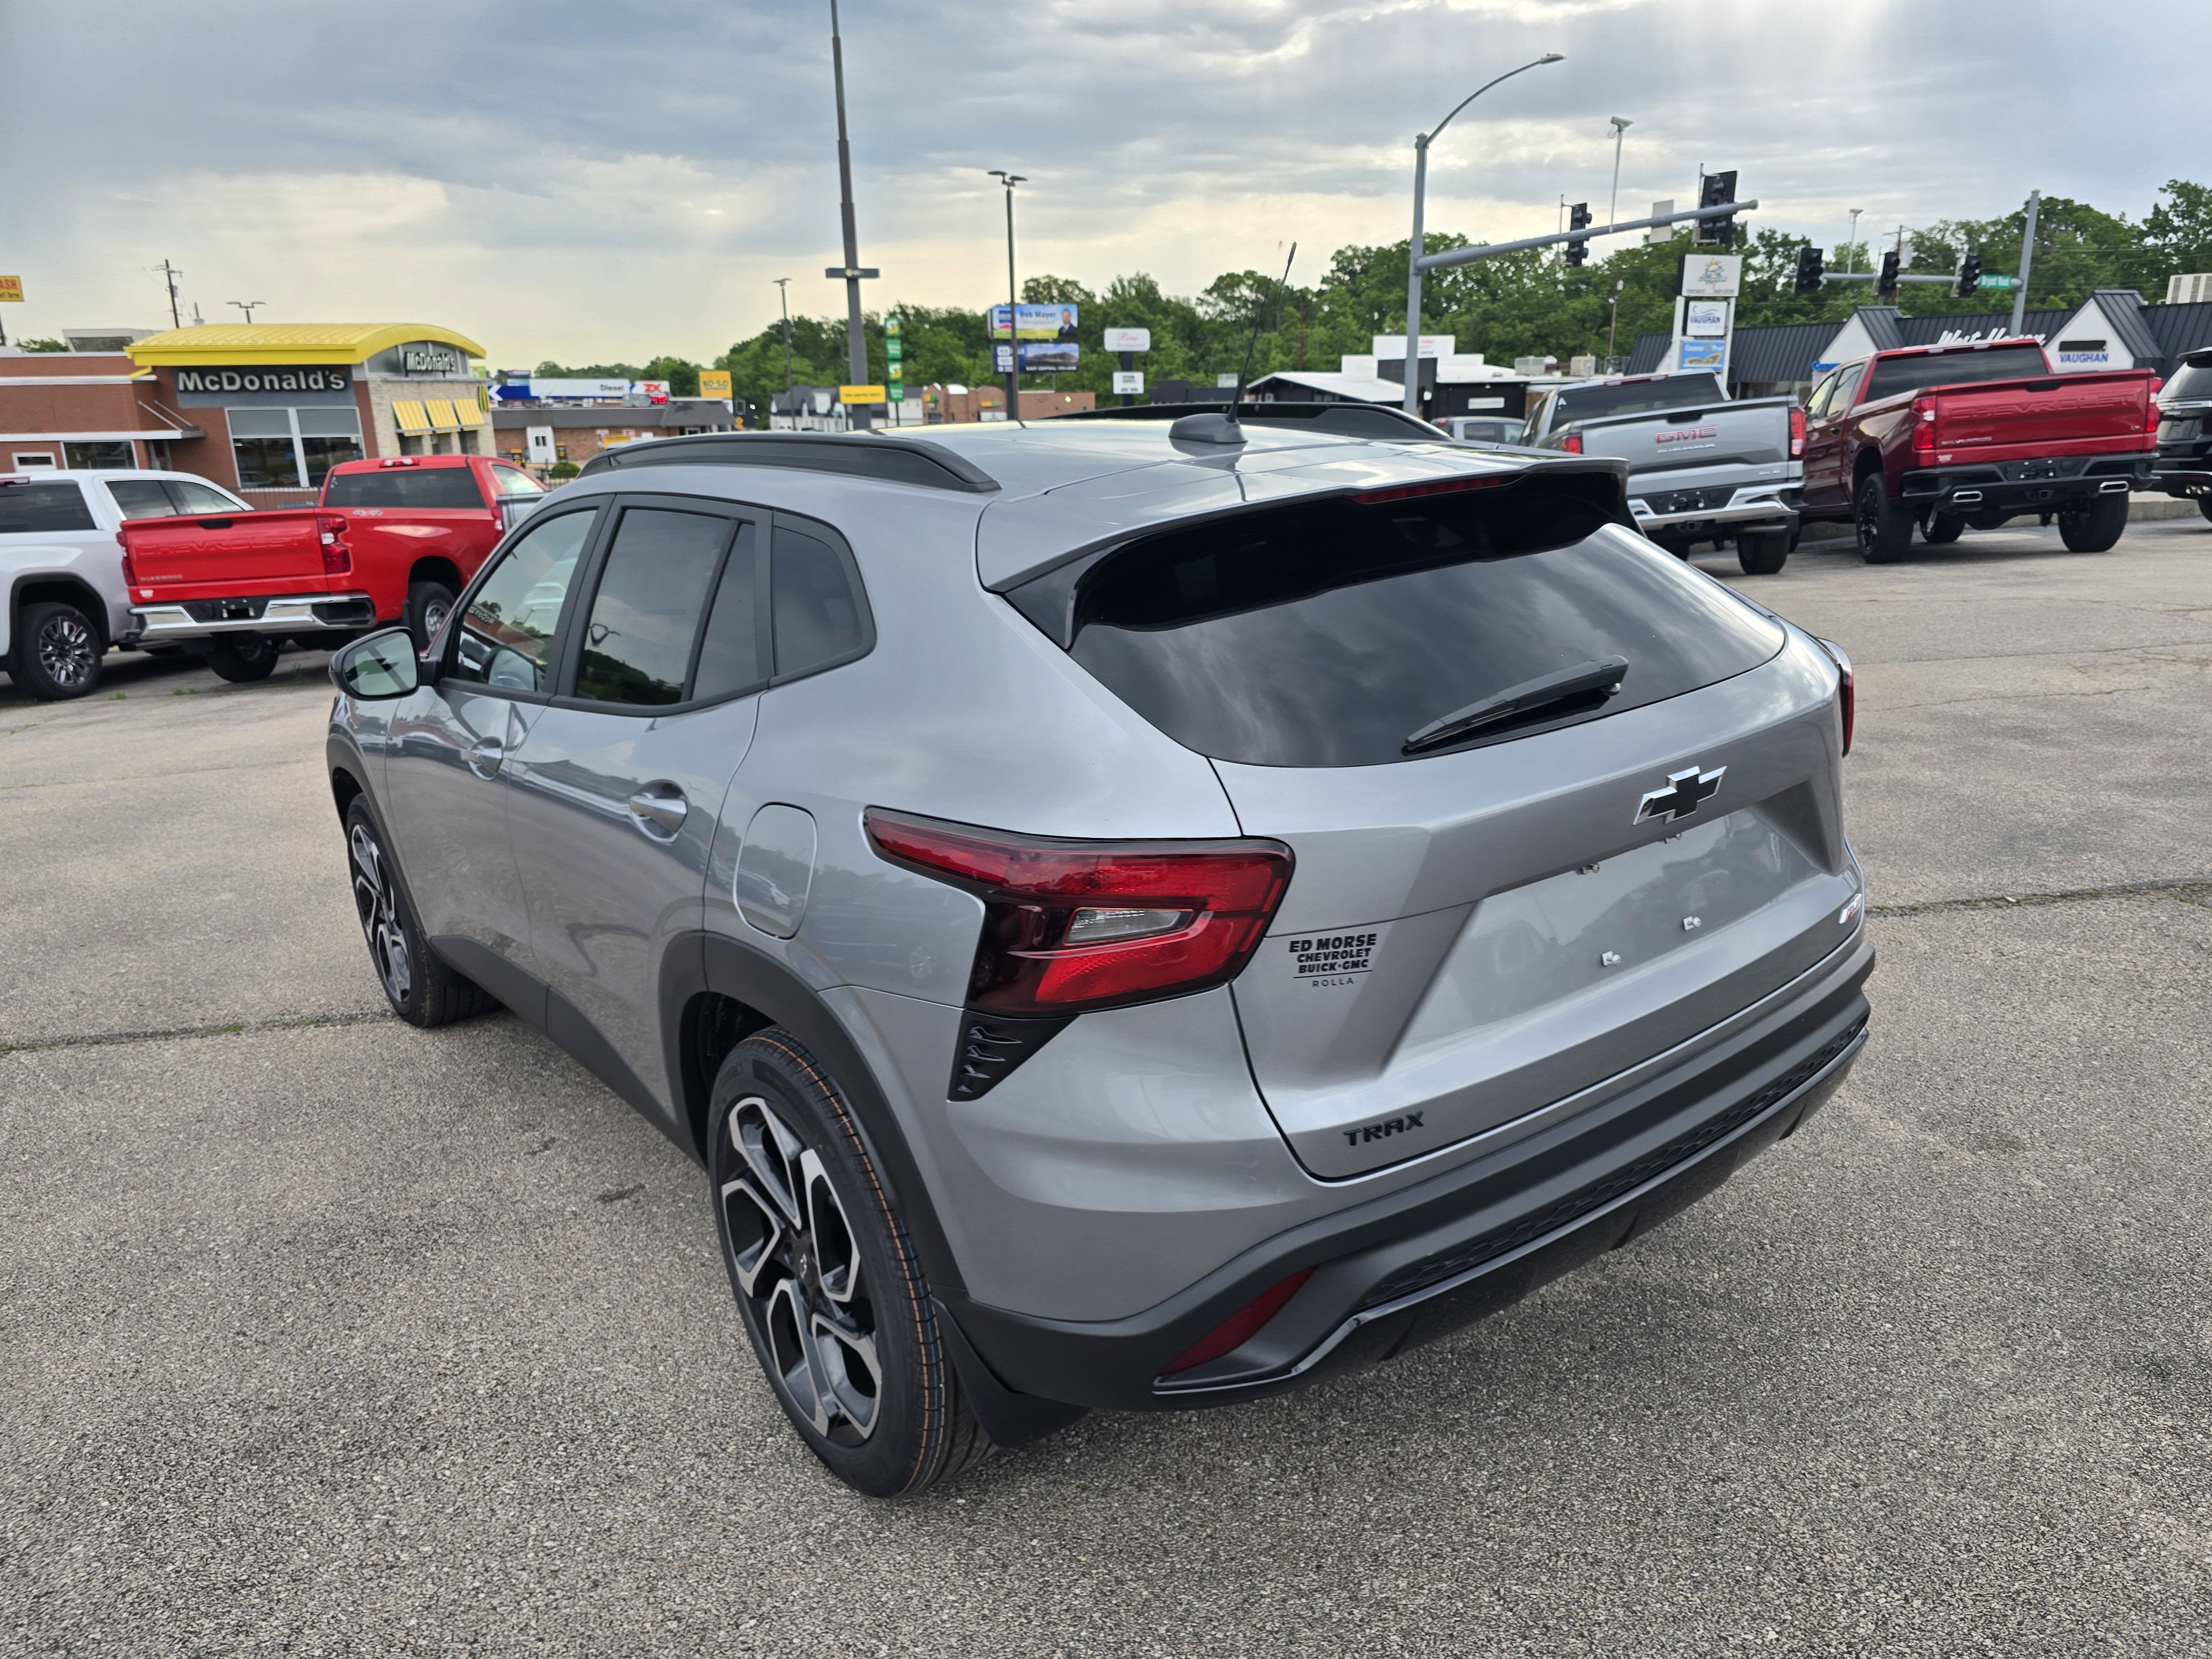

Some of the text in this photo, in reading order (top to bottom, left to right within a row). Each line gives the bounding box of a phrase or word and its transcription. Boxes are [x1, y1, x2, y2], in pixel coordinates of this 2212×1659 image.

[406, 352, 456, 371] McDonald's
[2060, 354, 2108, 362] VAUGHAN
[179, 371, 345, 391] McDonald's
[1655, 426, 1717, 443] GMC
[1289, 933, 1377, 952] ED MORSE
[1297, 947, 1371, 963] CHEVROLET
[1312, 977, 1354, 987] ROLLA
[1343, 1110, 1424, 1146] TRAX
